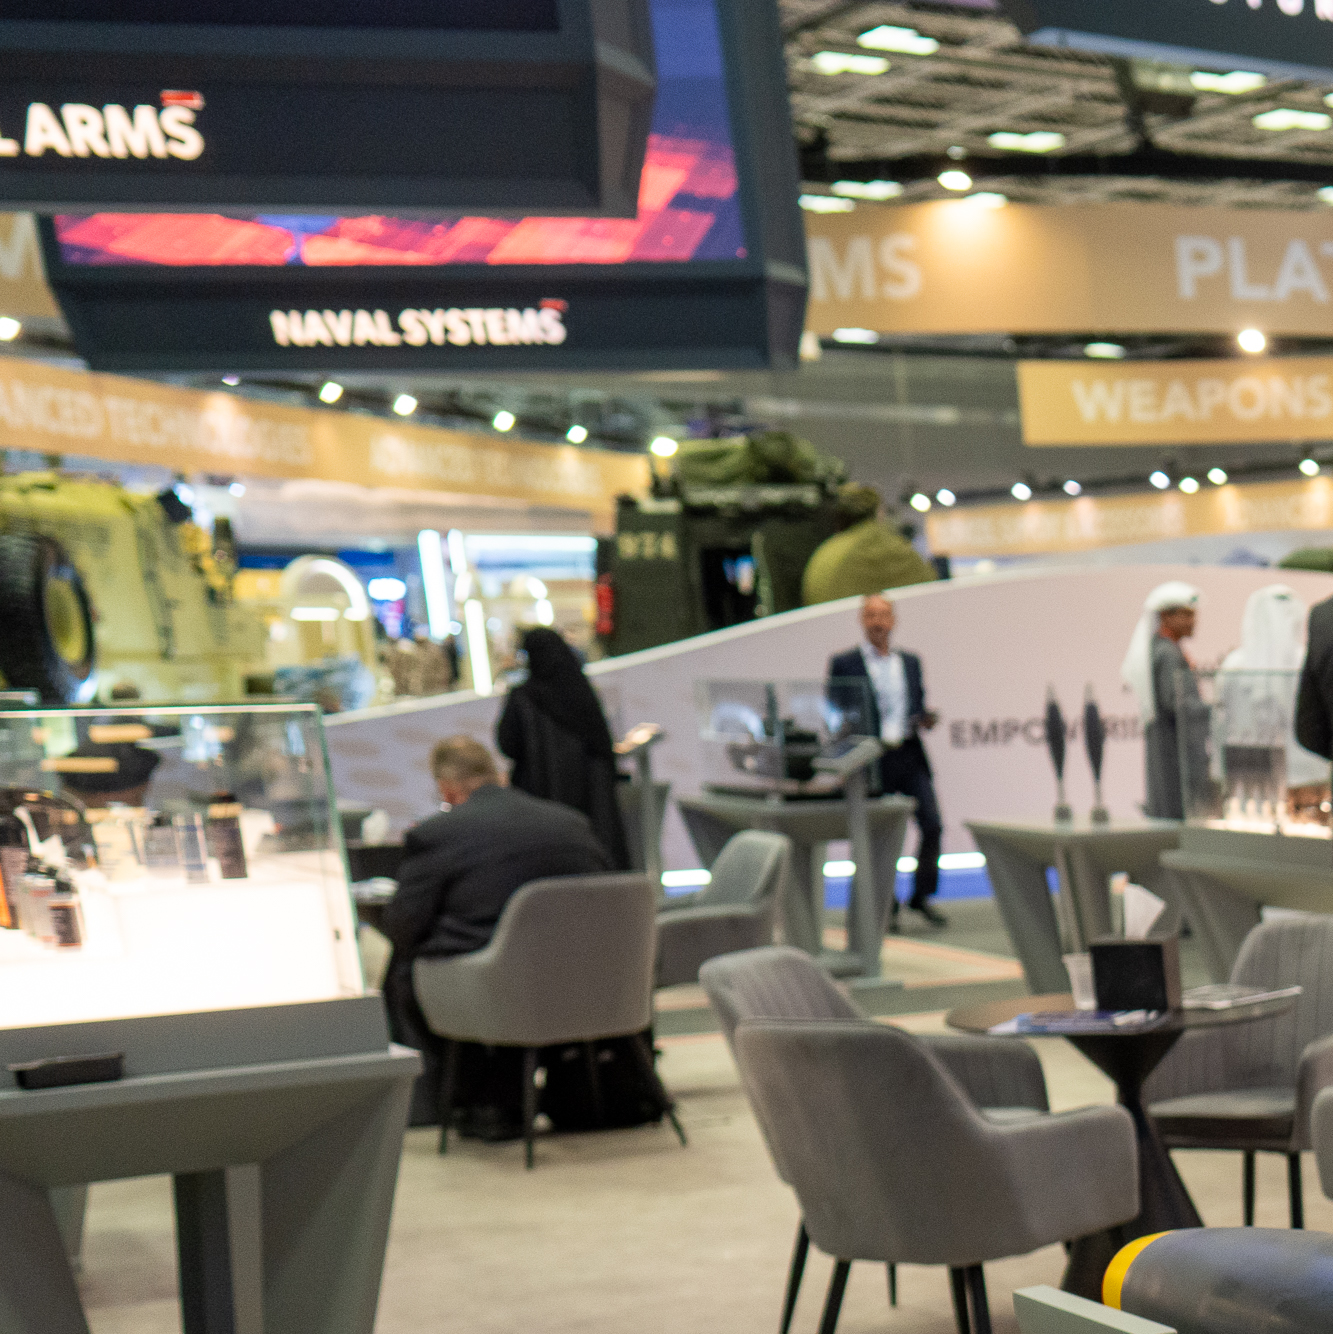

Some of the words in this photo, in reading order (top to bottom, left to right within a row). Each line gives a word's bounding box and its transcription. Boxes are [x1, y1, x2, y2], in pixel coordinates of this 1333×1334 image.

[24, 102, 204, 160] ARMS
[269, 309, 399, 347] NAVAL
[399, 308, 567, 347] SYSTEMS
[1072, 373, 1333, 424] WEAPONS
